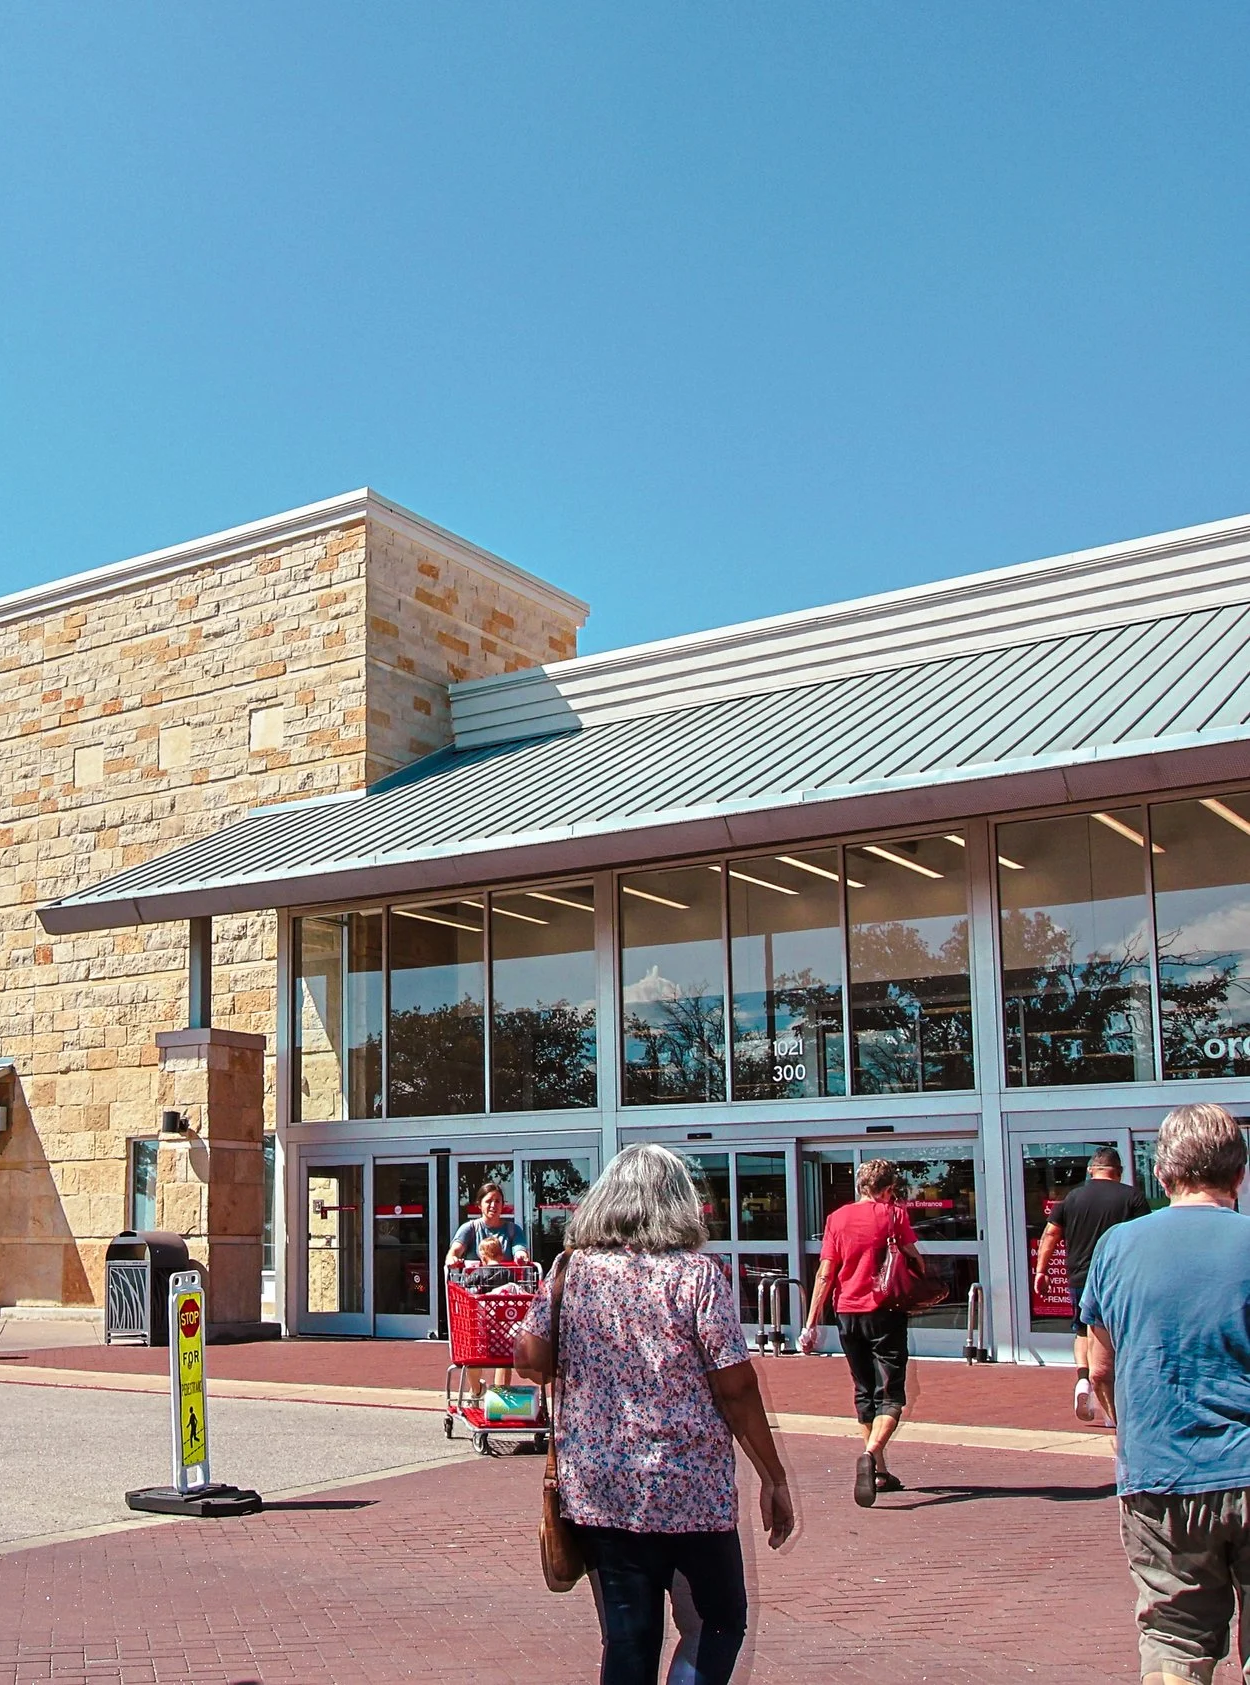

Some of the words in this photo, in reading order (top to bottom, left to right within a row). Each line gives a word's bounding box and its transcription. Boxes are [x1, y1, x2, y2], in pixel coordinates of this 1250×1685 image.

[772, 1039, 803, 1056] 1021
[772, 1064, 806, 1082] 300
[915, 1200, 943, 1208] Entrance
[181, 1311, 199, 1326] STOP
[183, 1350, 200, 1366] FOR
